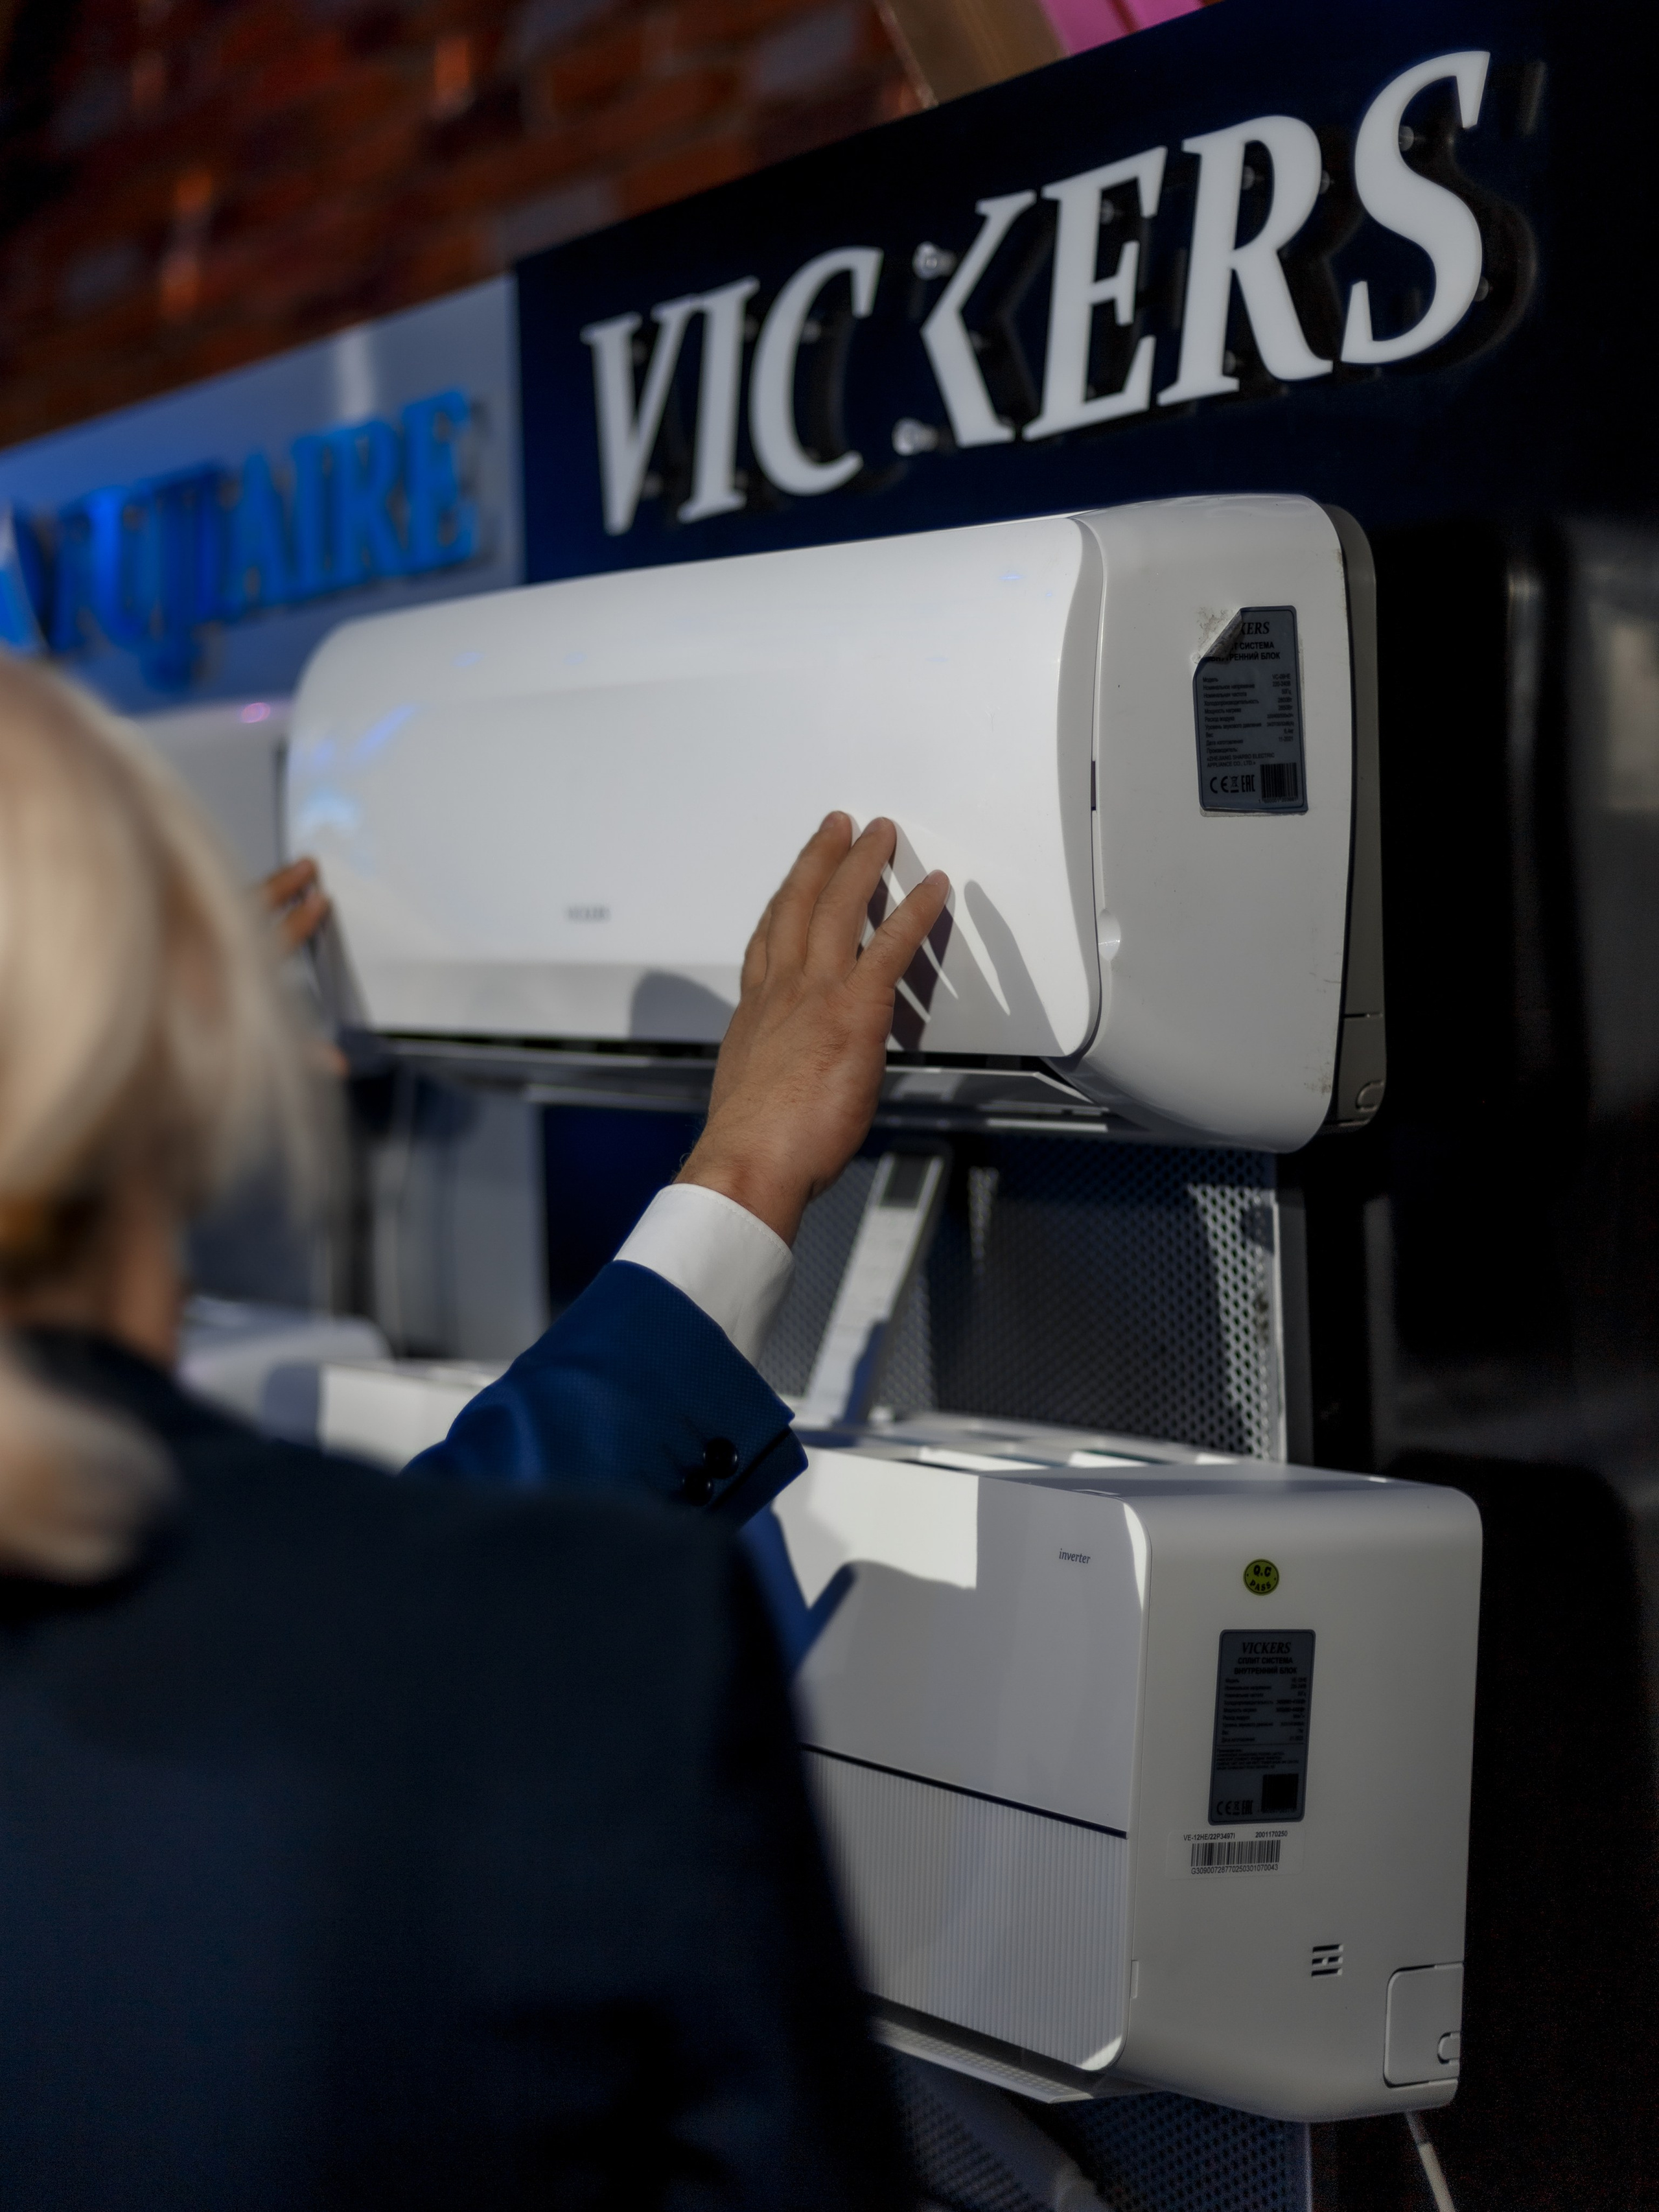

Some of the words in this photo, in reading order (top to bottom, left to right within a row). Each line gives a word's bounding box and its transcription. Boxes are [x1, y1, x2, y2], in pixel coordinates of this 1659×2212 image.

[581, 51, 1491, 535] VICKERS
[1240, 642, 1275, 650] СИСТЕМА
[1059, 1548, 1091, 1564] inverter
[1253, 1565, 1272, 1577] Q.C
[1249, 1579, 1272, 1592] PASS
[1242, 1642, 1292, 1654] VICKERS
[1234, 1666, 1278, 1675] ВНУТРЕННИЙ
[1255, 1830, 1288, 1839] 2001170250
